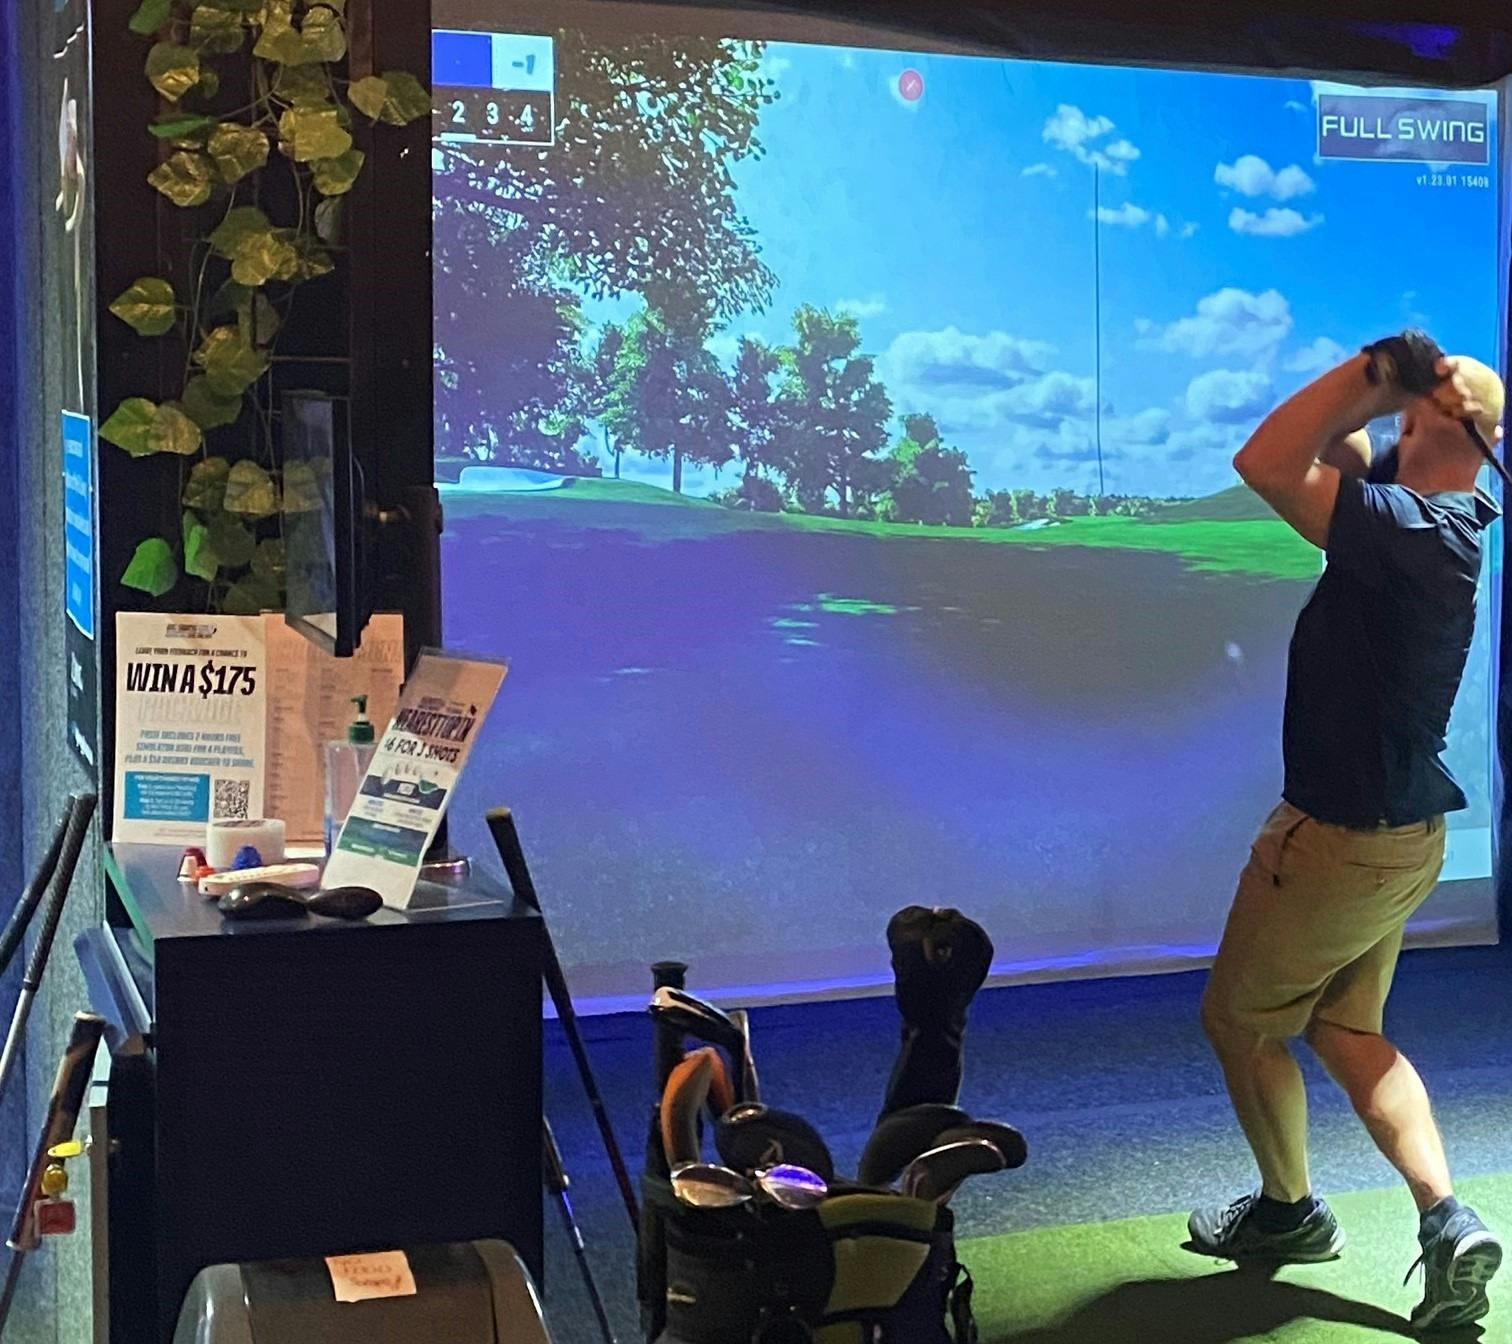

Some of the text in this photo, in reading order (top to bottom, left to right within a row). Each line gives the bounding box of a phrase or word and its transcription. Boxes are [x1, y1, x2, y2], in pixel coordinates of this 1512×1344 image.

[452, 100, 534, 128] 2 3 4
[1322, 115, 1485, 144] FULL SWING
[126, 659, 257, 699] WIN A $175
[394, 739, 418, 756] FOR
